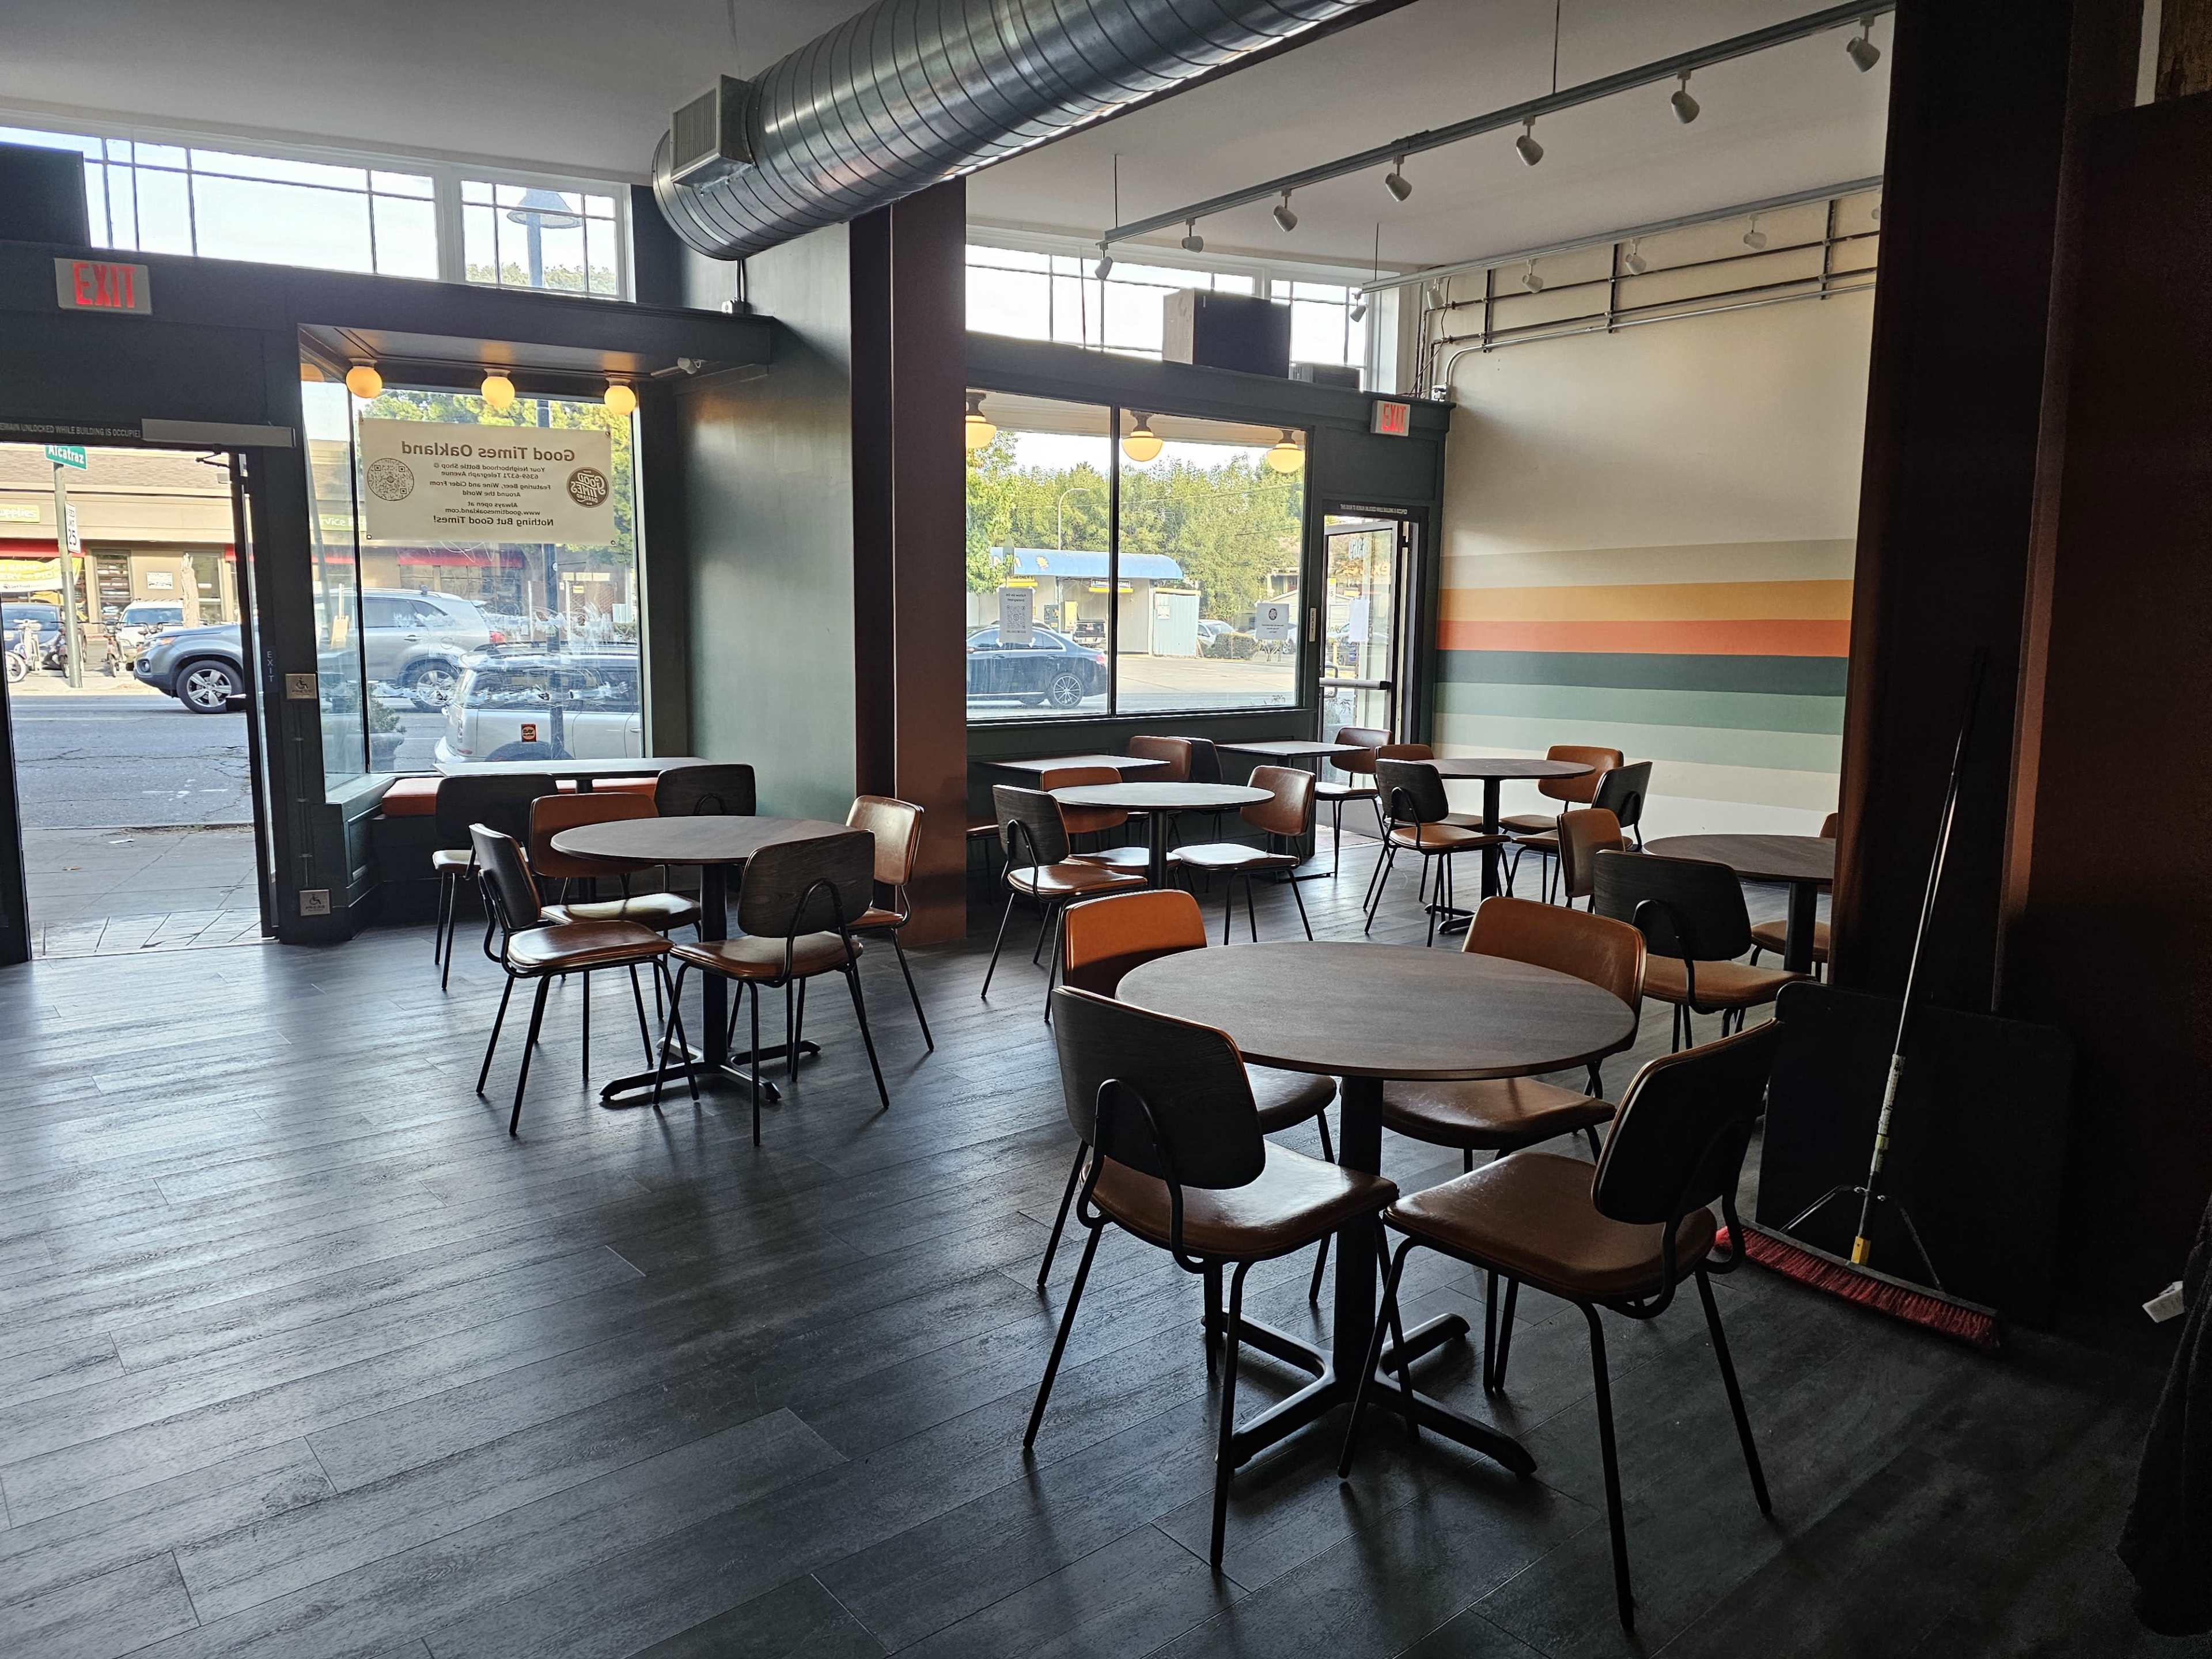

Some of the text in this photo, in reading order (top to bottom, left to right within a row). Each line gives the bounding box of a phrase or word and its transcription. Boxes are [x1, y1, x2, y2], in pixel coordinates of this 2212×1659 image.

[73, 261, 136, 308] EXIT
[1381, 403, 1406, 433] EXIT
[0, 422, 141, 438] EMAIN UNLOCKED WHILE BUILDING IS OCCUPIE
[48, 445, 85, 464] Alcatraz
[0, 506, 37, 518] upplies
[321, 517, 346, 527] rvice
[68, 528, 77, 546] 25
[267, 651, 275, 683] EXIT
